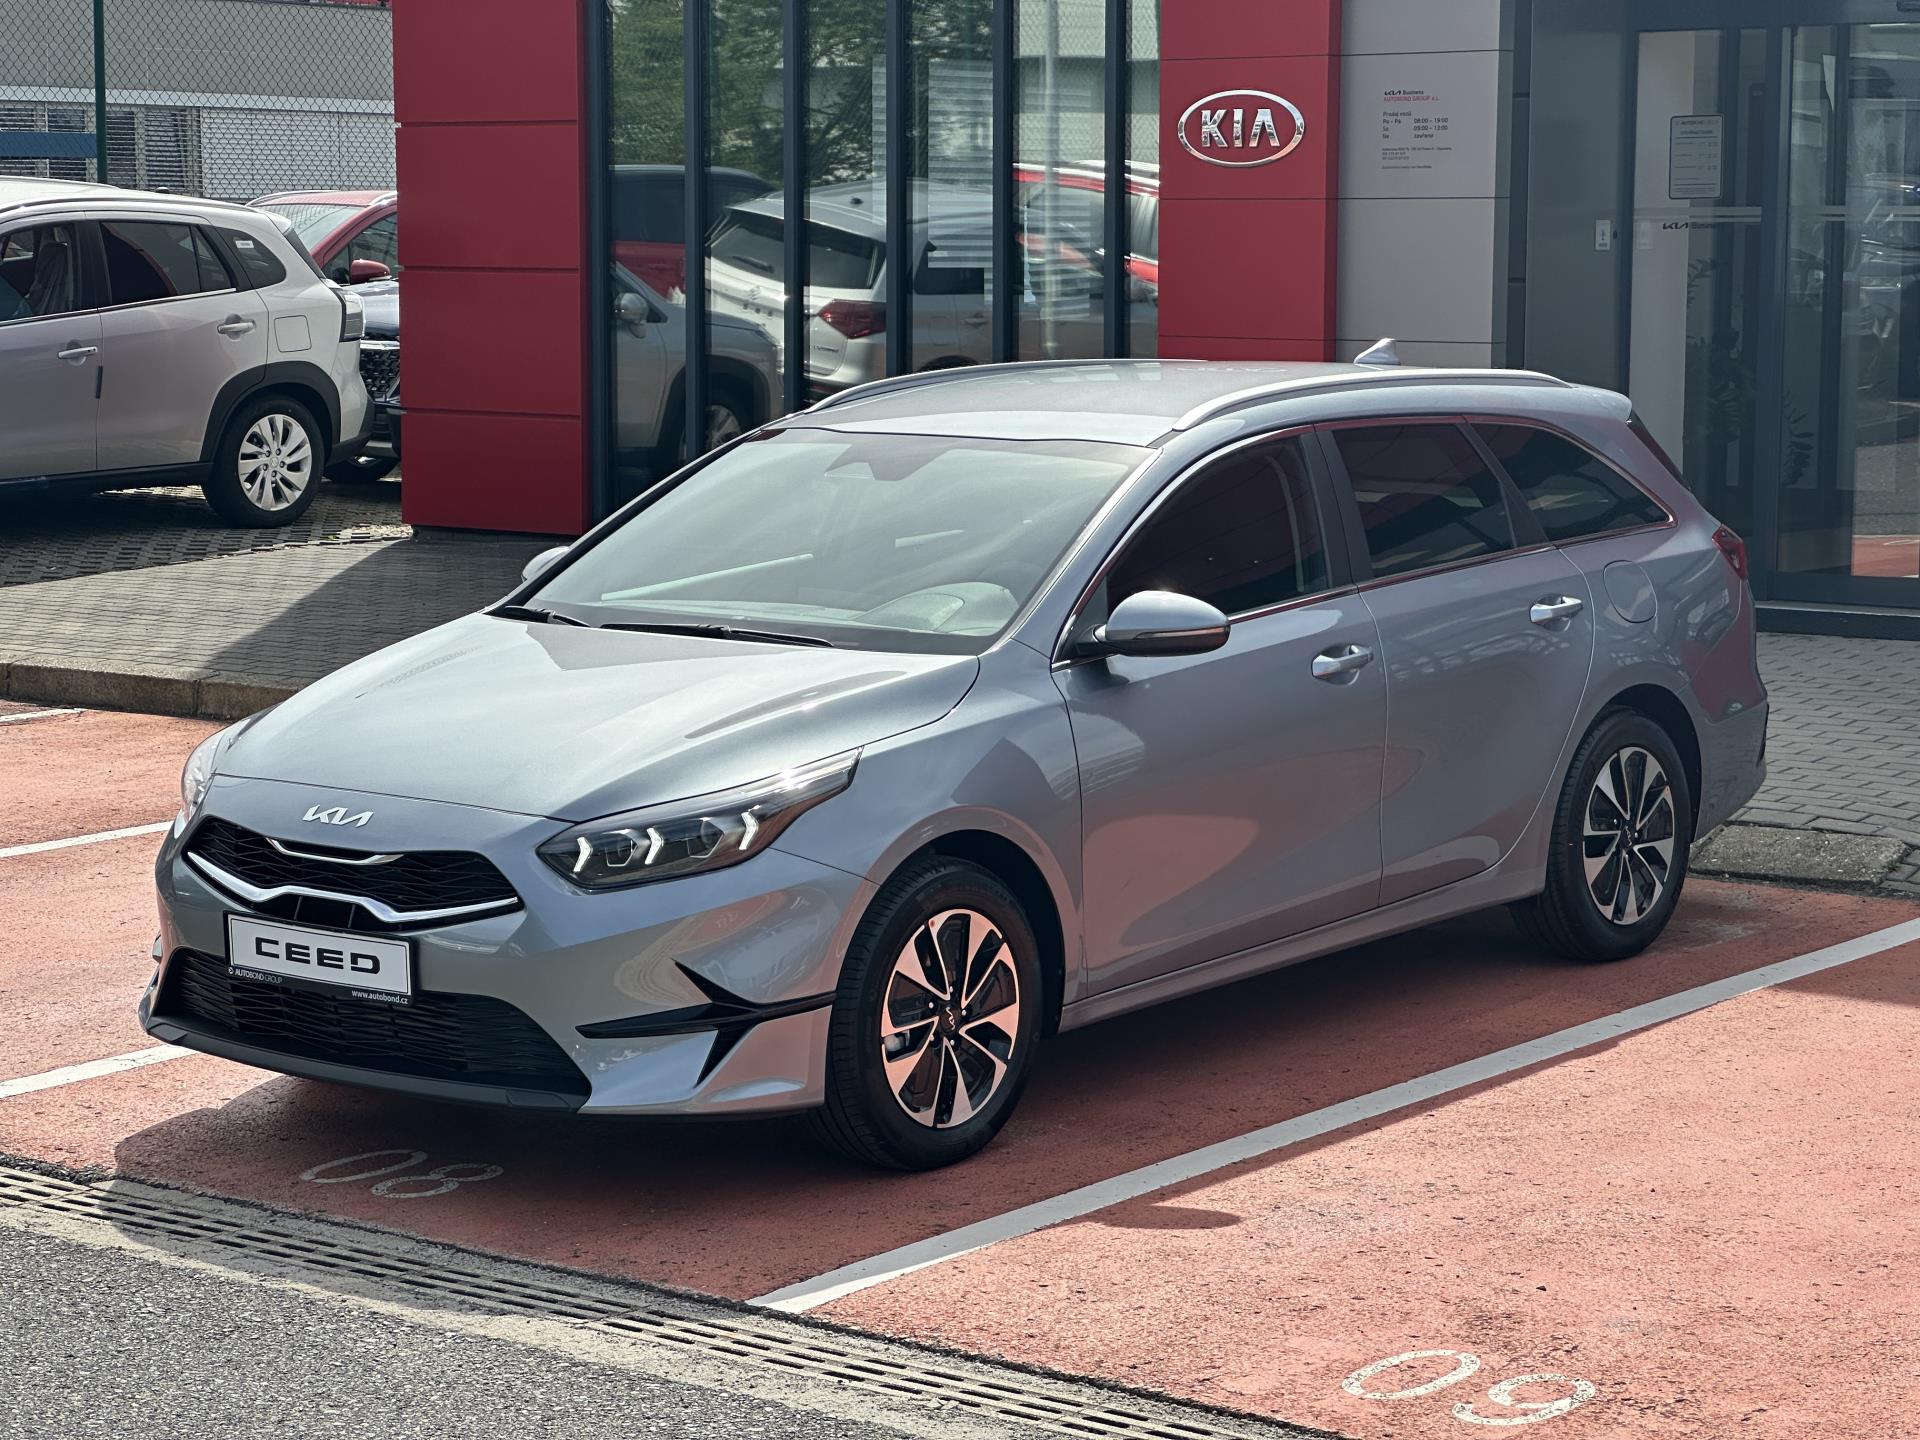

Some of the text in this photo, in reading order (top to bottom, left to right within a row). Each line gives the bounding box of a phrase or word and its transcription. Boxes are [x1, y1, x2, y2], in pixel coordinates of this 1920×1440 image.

[1201, 108, 1280, 147] KIA
[1662, 222, 1689, 230] KIA
[302, 804, 374, 828] KIA
[255, 936, 381, 975] CEED
[234, 967, 283, 984] AUTOBOND GROUP
[351, 989, 409, 1005] www.autobond.cz
[300, 1149, 504, 1199] 08
[1341, 1349, 1596, 1426] 09
